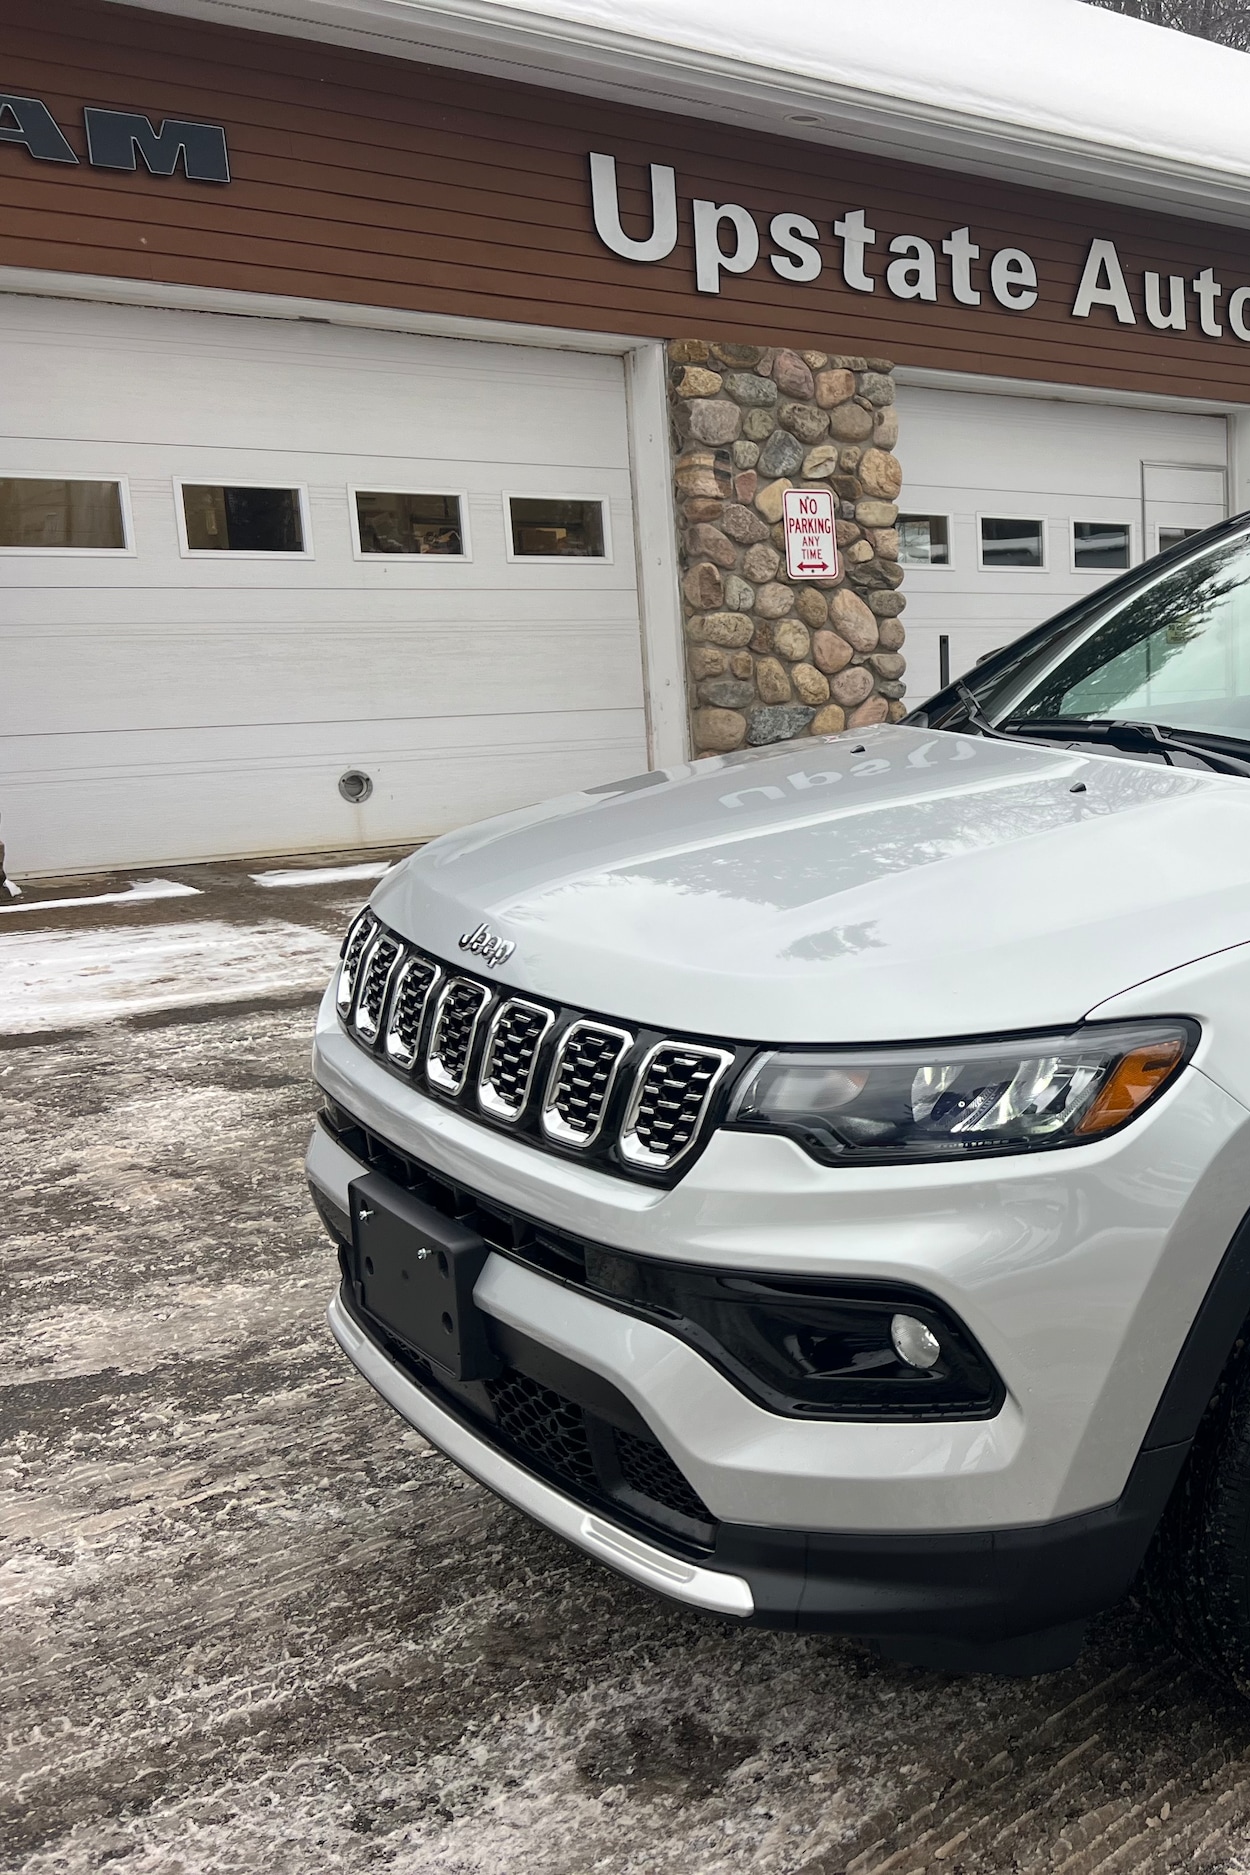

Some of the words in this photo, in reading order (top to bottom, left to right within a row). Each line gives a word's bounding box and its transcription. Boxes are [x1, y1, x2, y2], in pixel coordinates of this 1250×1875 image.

[589, 151, 1039, 311] Upstate
[799, 498, 818, 514] NO
[789, 517, 831, 534] PARKING
[802, 536, 820, 547] ANY
[801, 549, 823, 560] TIME
[458, 923, 517, 970] Jeep
